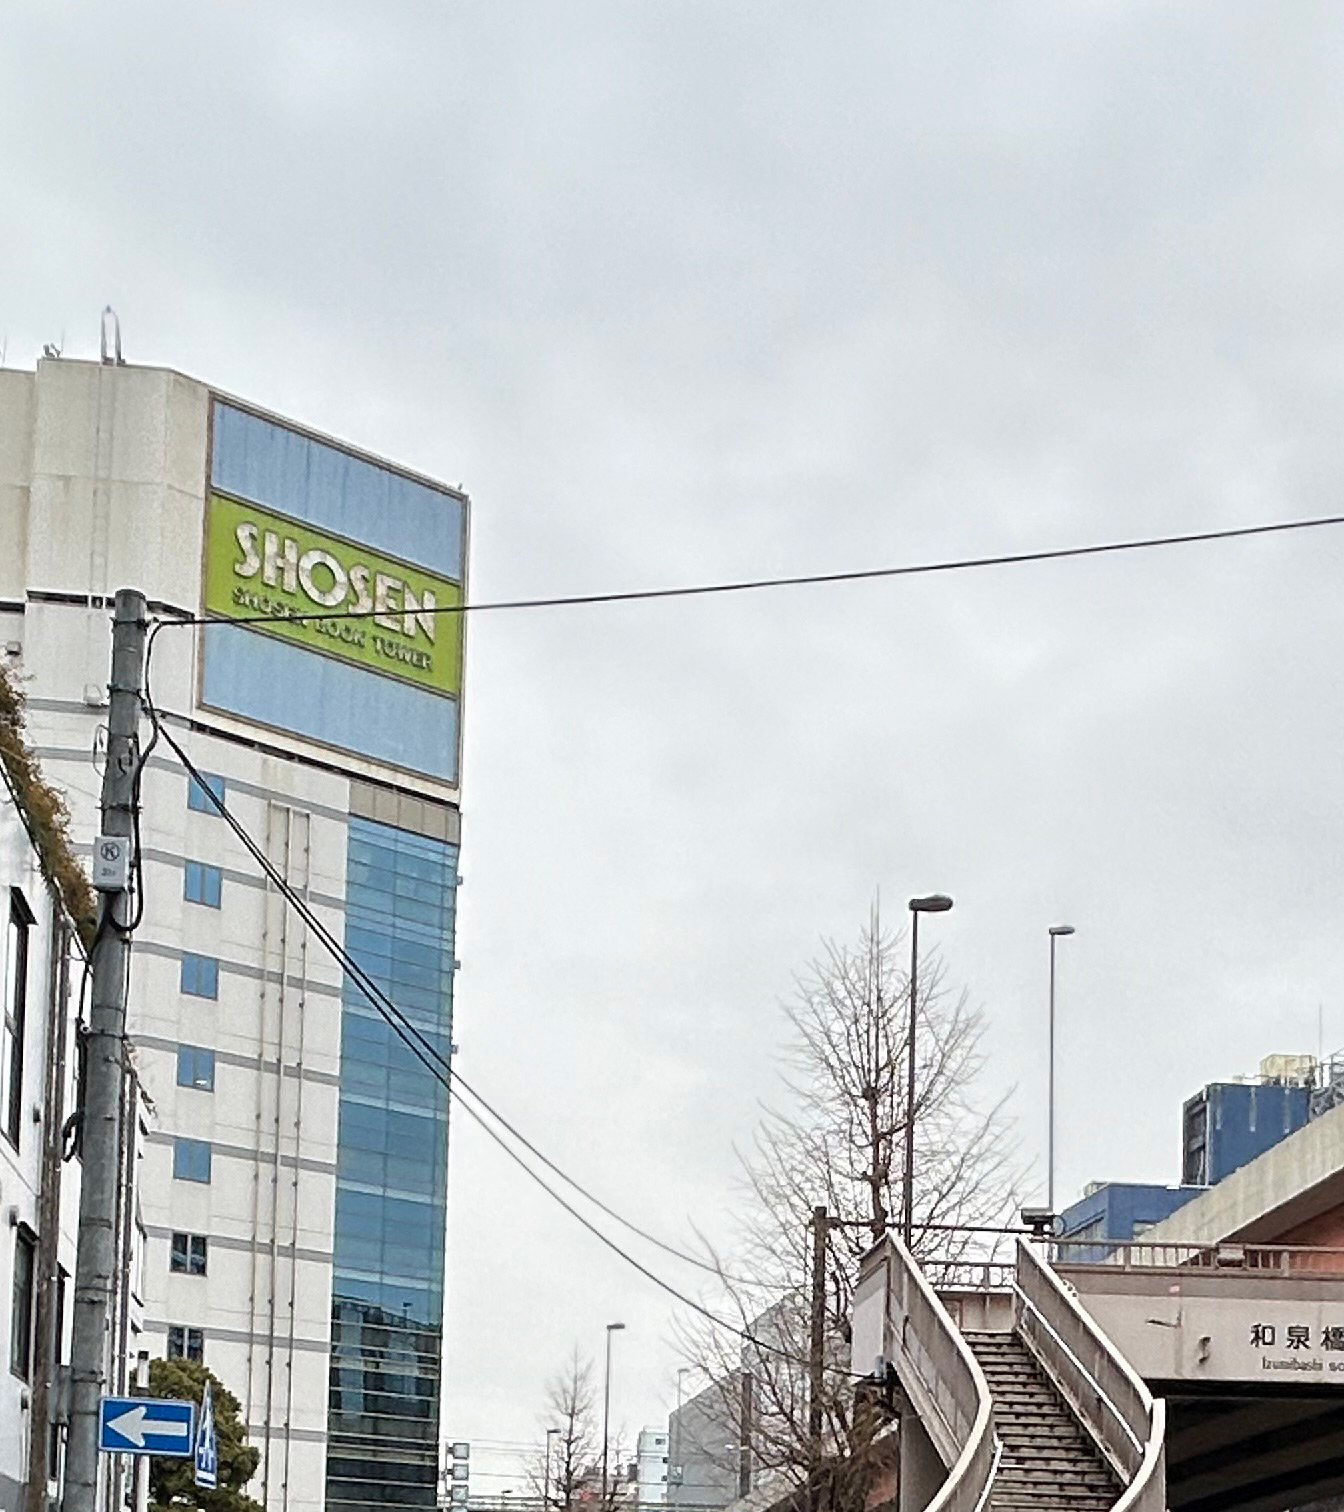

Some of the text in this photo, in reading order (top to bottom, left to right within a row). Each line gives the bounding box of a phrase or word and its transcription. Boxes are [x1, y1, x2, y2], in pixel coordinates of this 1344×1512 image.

[233, 520, 436, 646] SHOSEN
[314, 618, 366, 648] BOOK
[372, 634, 434, 673] TOWER
